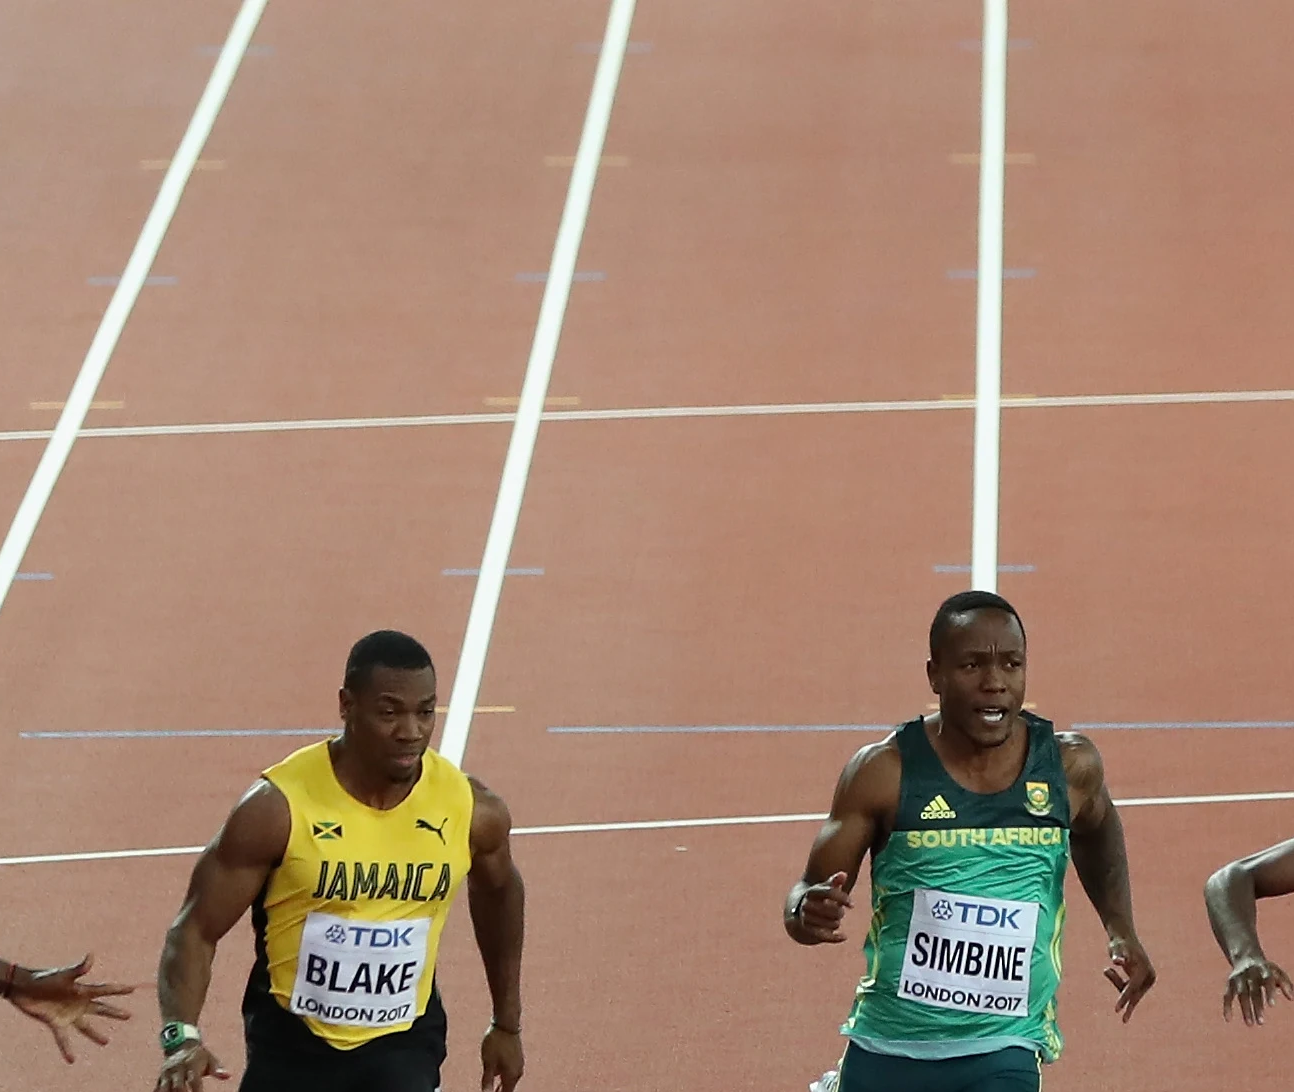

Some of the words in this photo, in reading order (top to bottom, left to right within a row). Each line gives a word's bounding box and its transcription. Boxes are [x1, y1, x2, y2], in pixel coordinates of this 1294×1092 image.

[920, 810, 956, 820] adidas
[906, 829, 989, 849] SOUTH
[990, 827, 1062, 848] AFRICA
[312, 860, 452, 901] JAMAICA
[954, 901, 1022, 930] TDK
[348, 925, 415, 949] TDK
[911, 931, 1026, 982] SIMBINE
[305, 953, 418, 996] BLAKE
[296, 995, 374, 1022] LONDON
[375, 1003, 412, 1023] 2017
[904, 980, 981, 1008] LONDON
[983, 995, 1022, 1012] 2017
